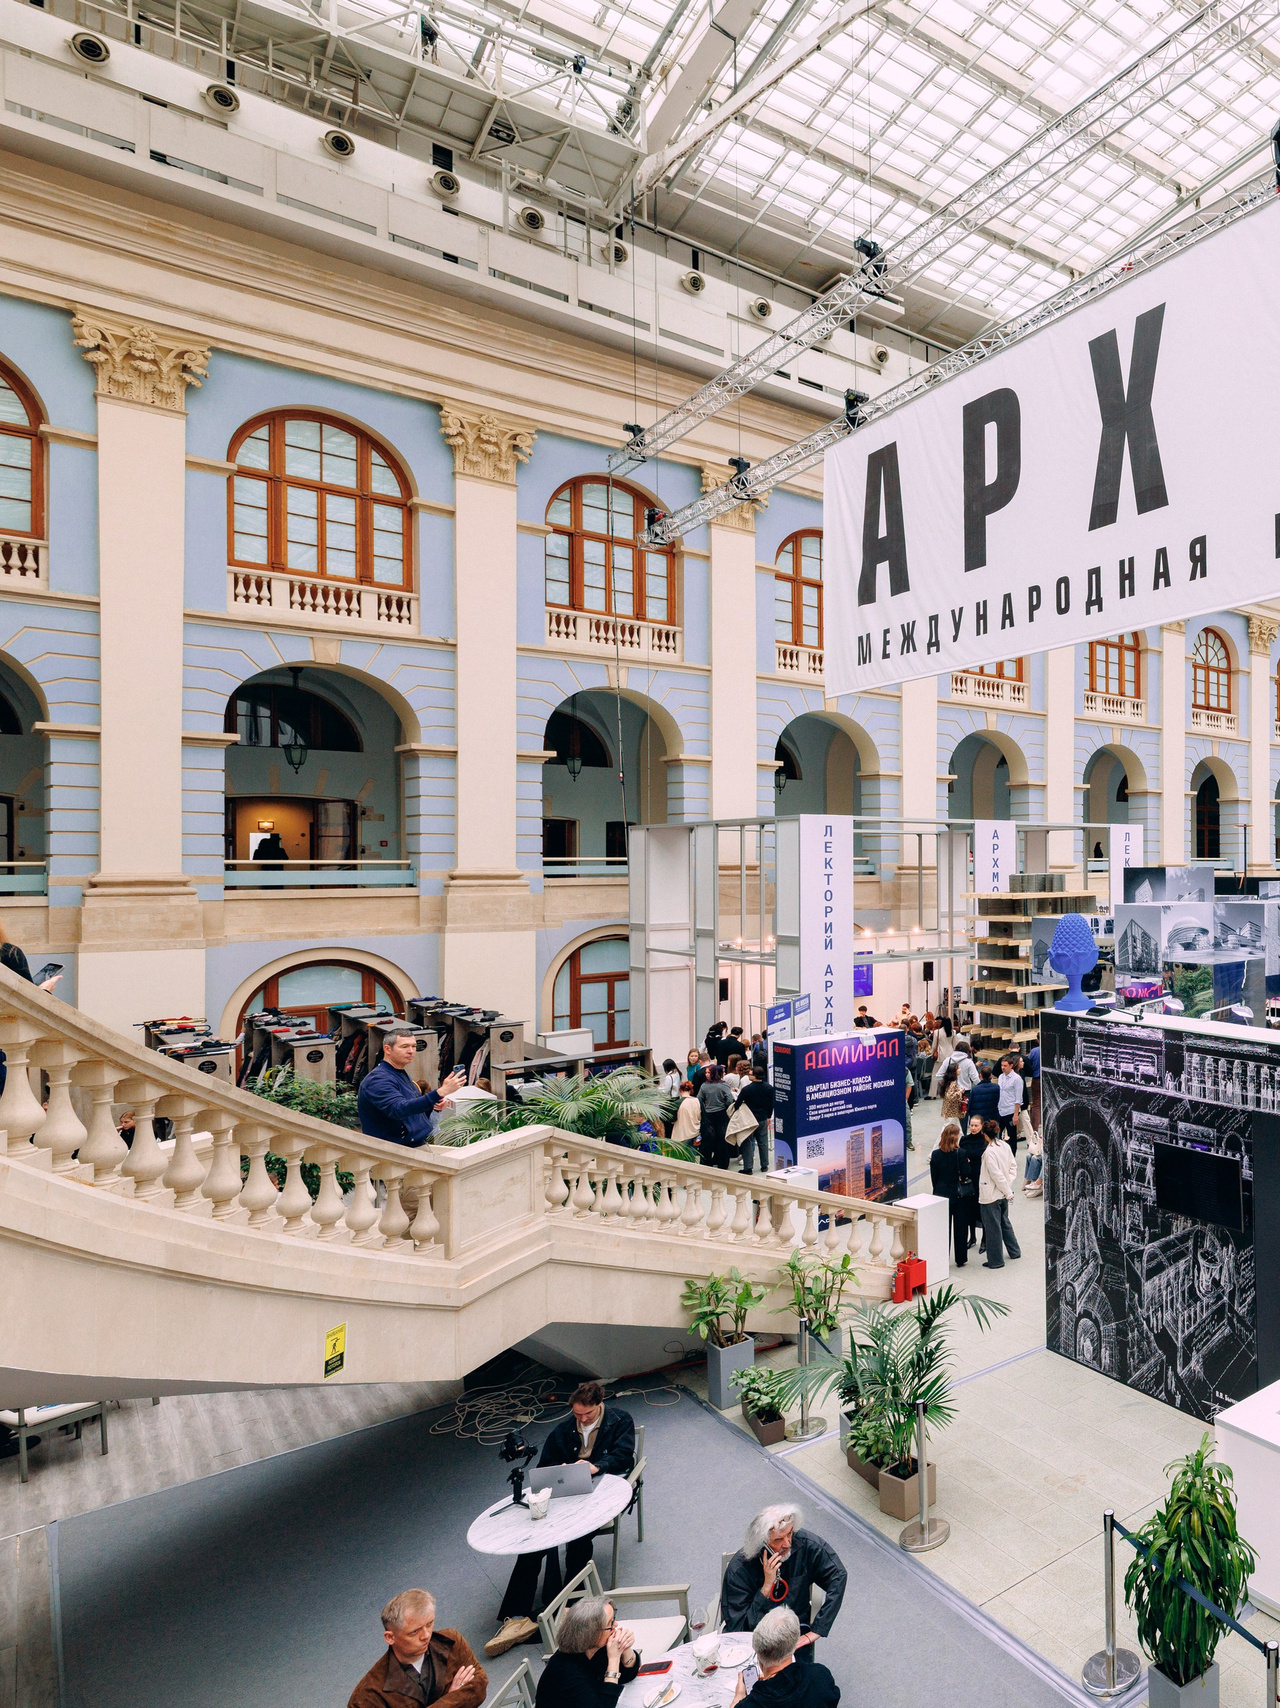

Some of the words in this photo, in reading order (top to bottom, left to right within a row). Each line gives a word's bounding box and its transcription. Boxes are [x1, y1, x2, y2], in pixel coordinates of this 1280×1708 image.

[857, 302, 1169, 607] АРХ
[857, 534, 1208, 666] МЕЖДУНАРОДНАЯ
[823, 824, 834, 951] ЛЕКТОРИЙ
[805, 1038, 899, 1070] АДМИРАЛ
[805, 1083, 830, 1094] КВАРТАЛ
[830, 1075, 872, 1090] БИЗНЕС-КЛАССА
[806, 1093, 811, 1101] В
[811, 1086, 852, 1101] АМБИЦИОЗНОМ
[852, 1082, 873, 1094] РАЙОНЕ
[873, 1079, 895, 1089] МОСКВЫ
